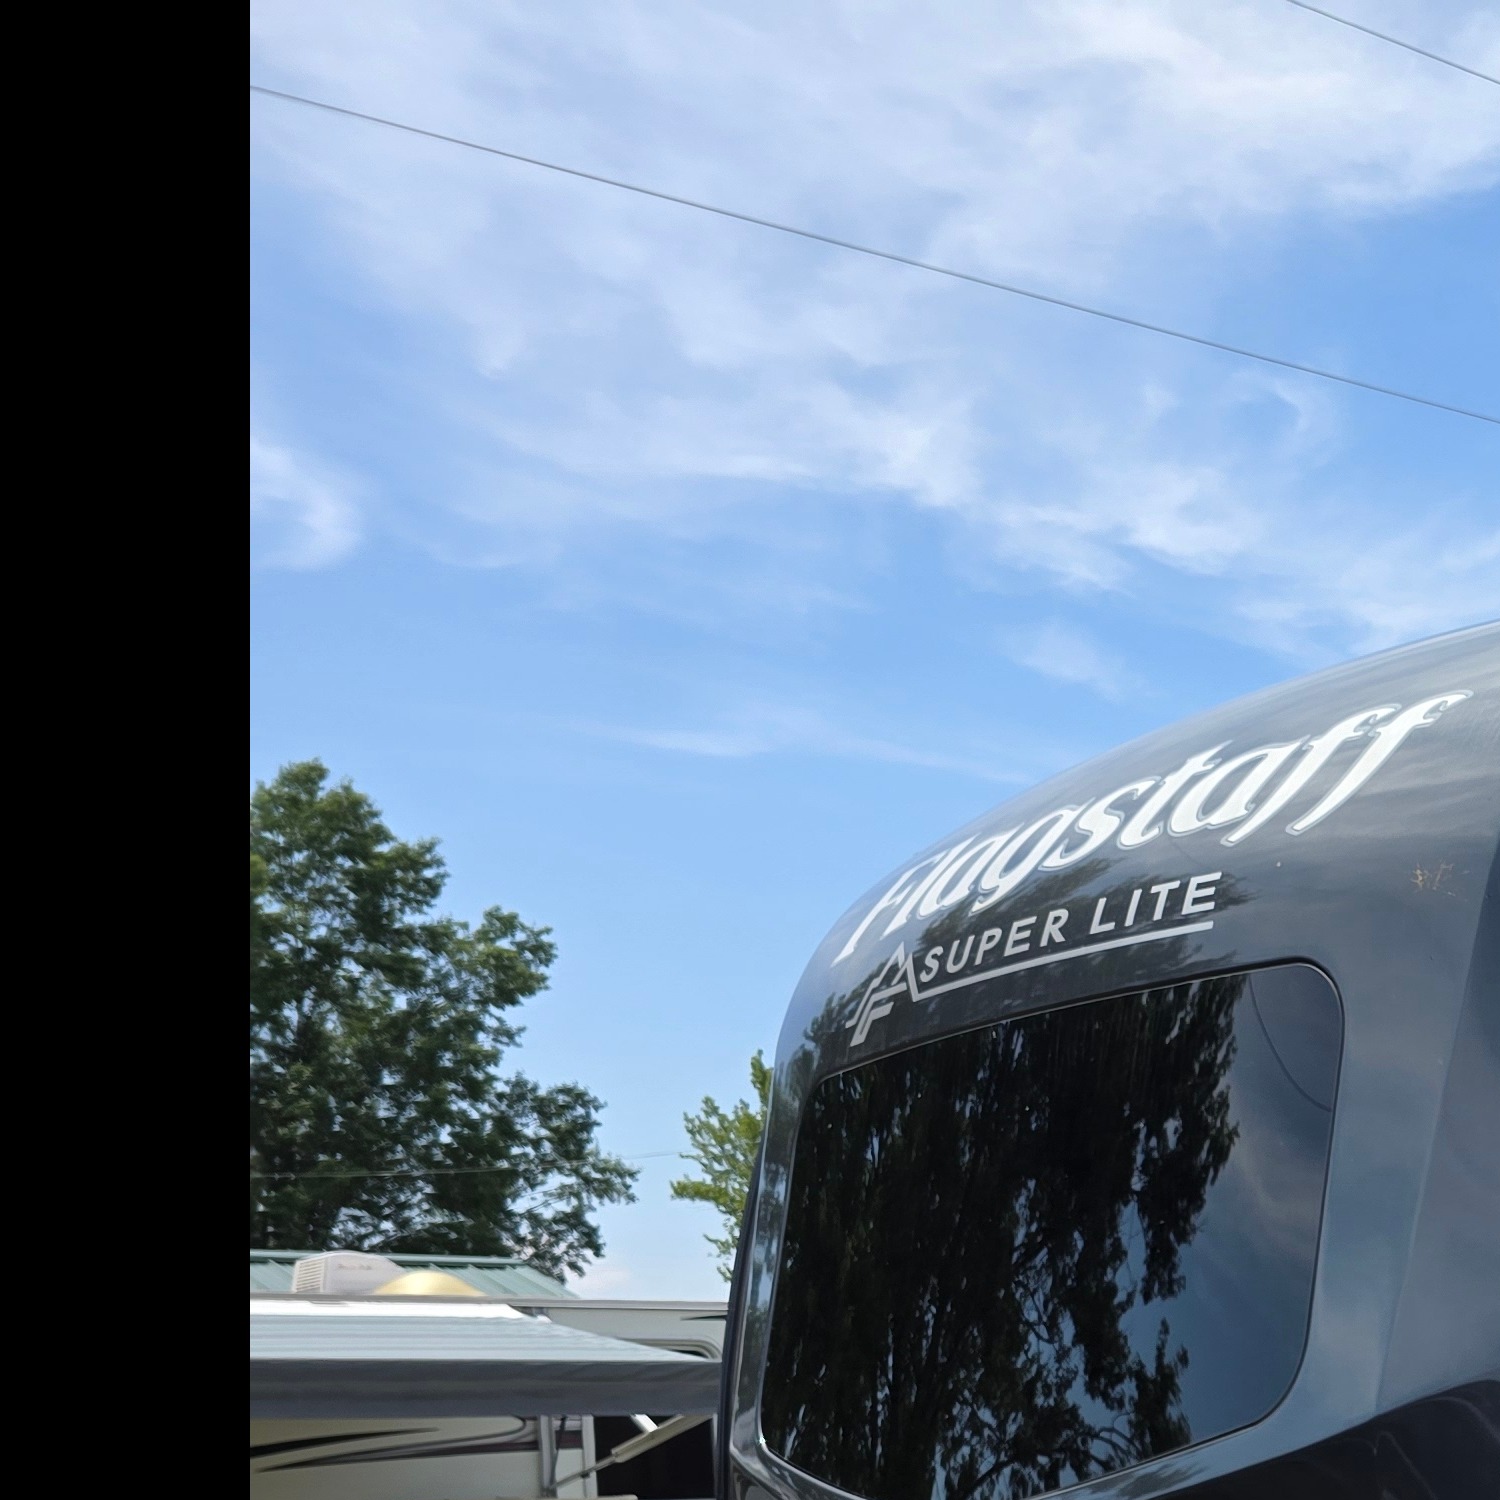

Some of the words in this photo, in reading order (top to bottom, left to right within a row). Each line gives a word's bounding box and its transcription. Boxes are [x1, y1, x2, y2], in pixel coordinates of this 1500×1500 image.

[831, 689, 1474, 967] Flagstaff
[920, 908, 1069, 983] SUPER
[1089, 870, 1223, 935] LITE
